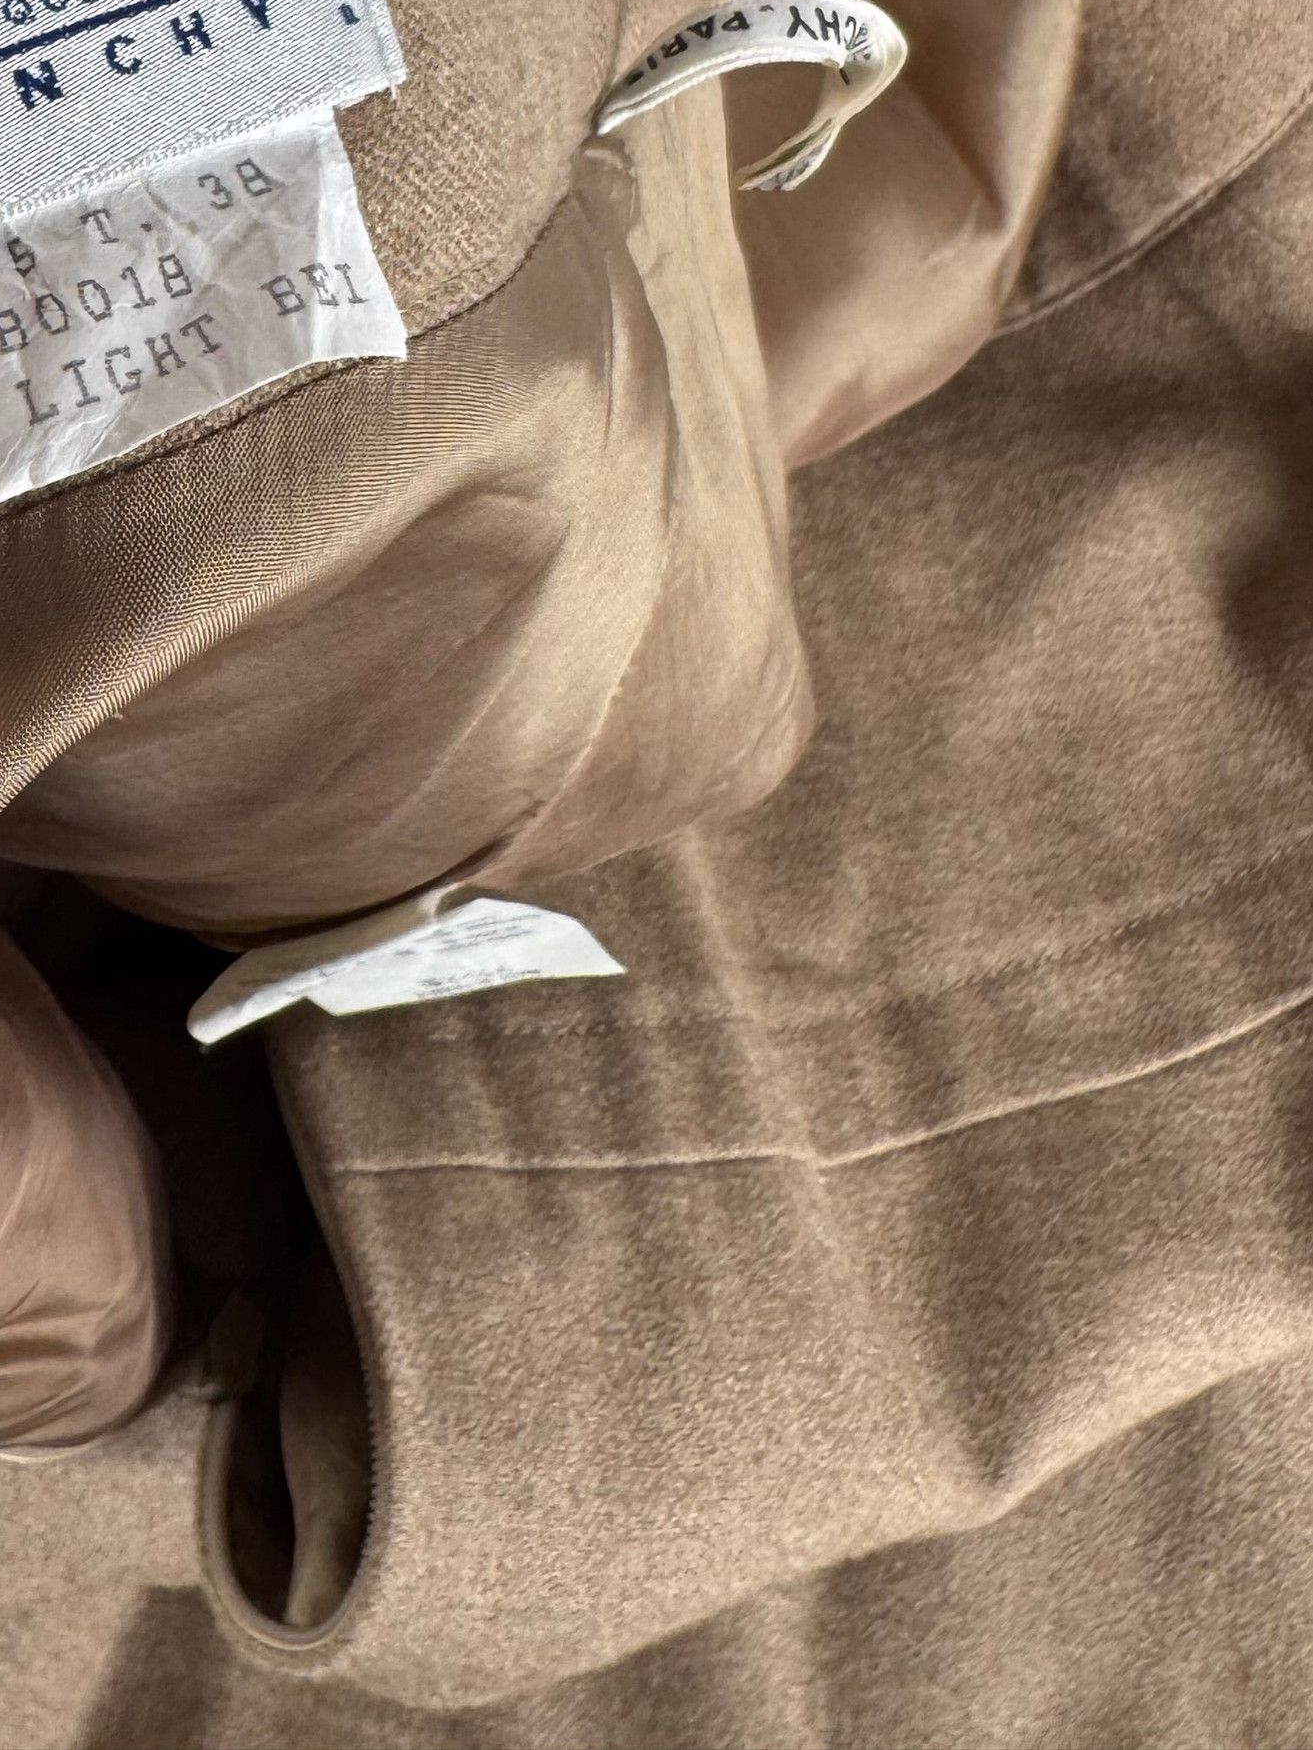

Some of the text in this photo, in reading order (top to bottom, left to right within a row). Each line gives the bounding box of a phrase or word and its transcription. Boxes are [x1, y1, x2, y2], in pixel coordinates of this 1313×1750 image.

[197, 158, 272, 210] 38
[14, 313, 223, 426] LIGHT
[257, 262, 369, 316] BEI
